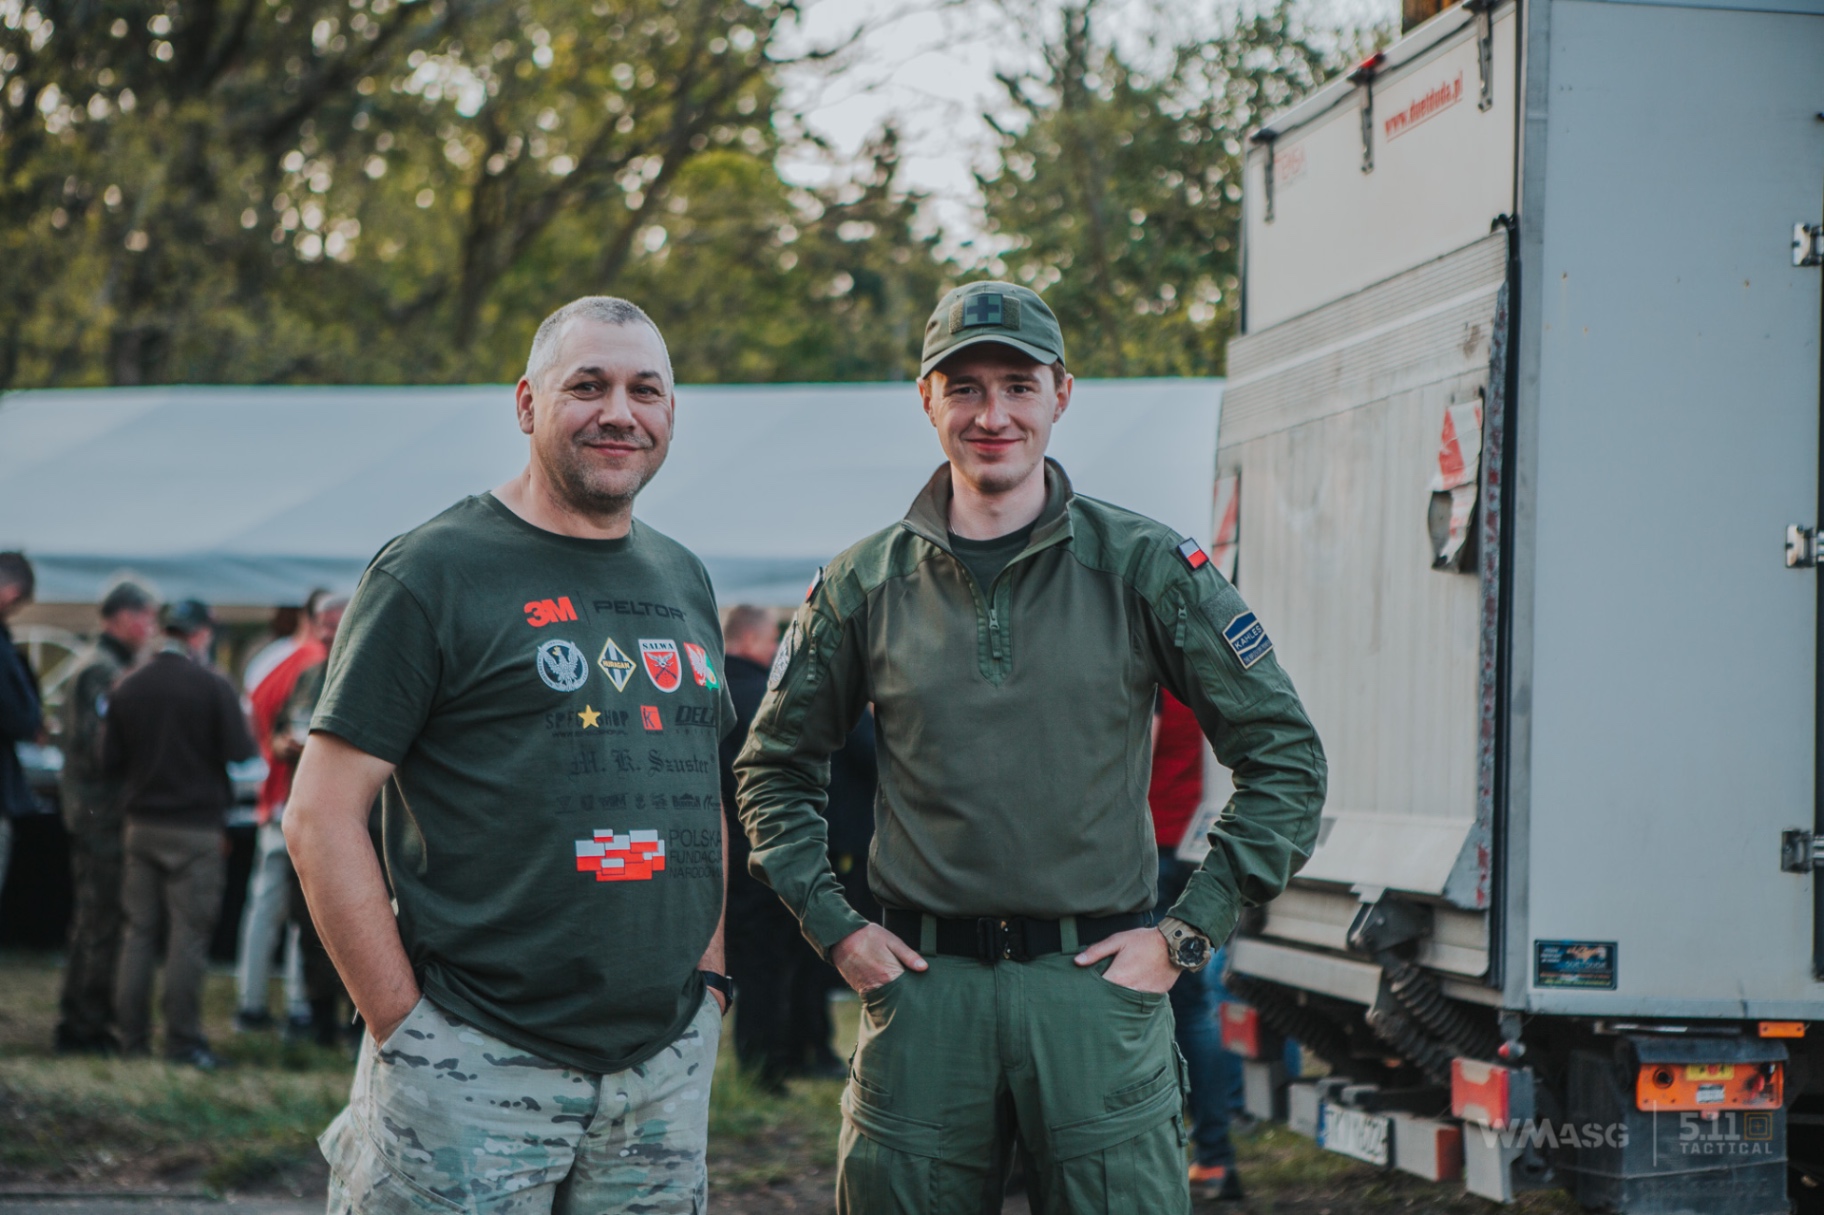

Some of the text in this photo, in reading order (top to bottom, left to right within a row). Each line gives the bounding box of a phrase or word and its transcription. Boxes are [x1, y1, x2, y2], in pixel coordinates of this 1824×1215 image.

[523, 596, 686, 628] 3M PELTOR
[642, 642, 674, 650] SALWA
[1234, 625, 1262, 650] KAHLES
